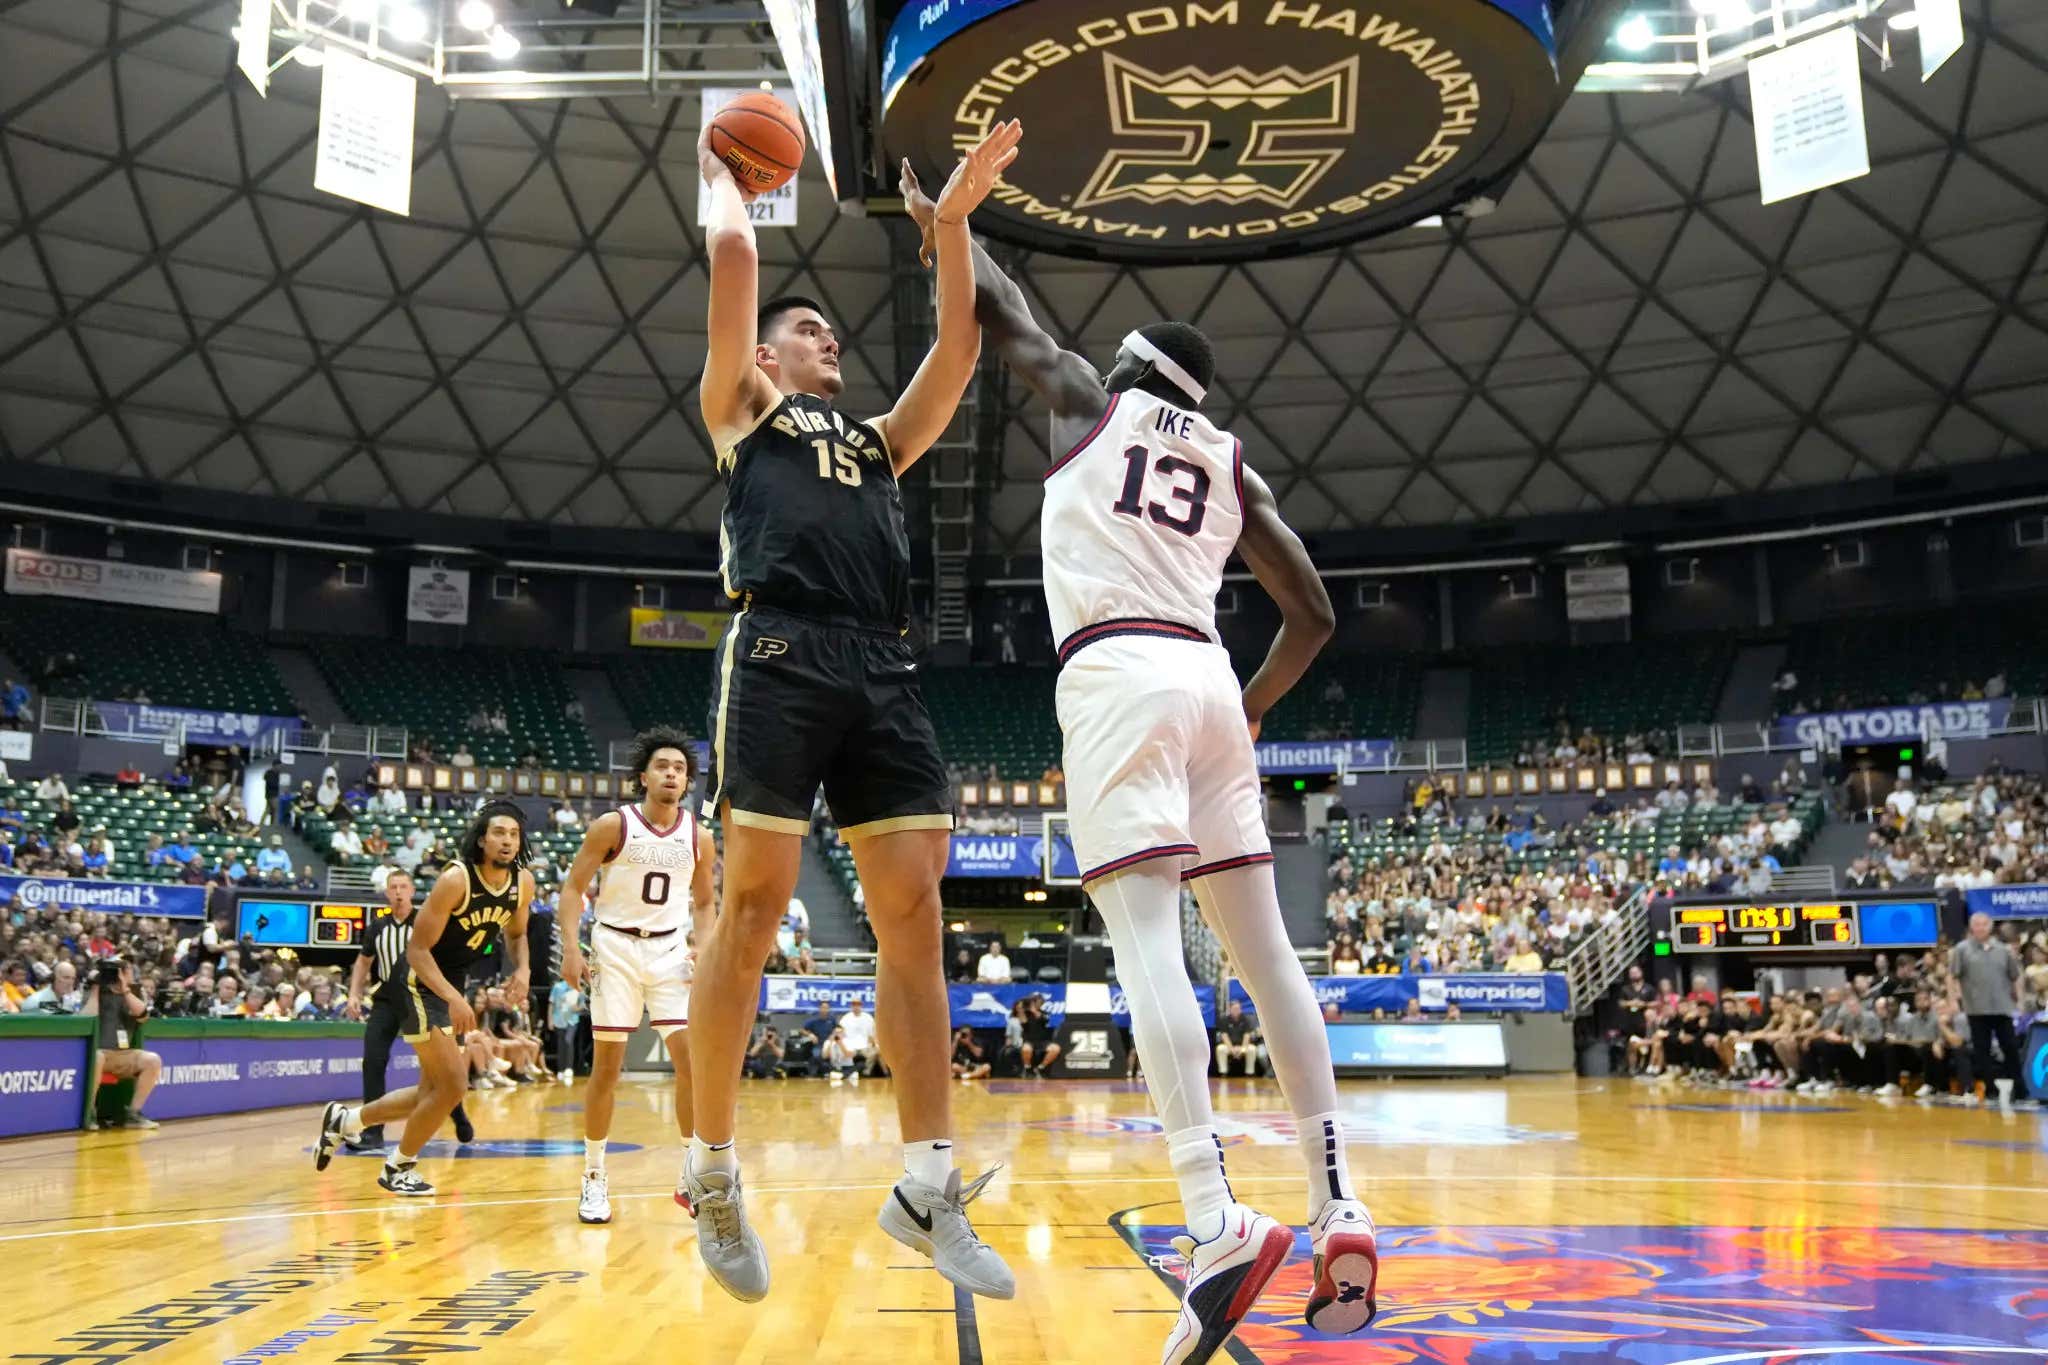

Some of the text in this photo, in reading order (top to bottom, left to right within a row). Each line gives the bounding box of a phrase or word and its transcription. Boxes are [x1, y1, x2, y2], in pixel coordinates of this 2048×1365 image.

[770, 406, 882, 462] PURDUE
[1155, 406, 1194, 440] IKE
[811, 439, 862, 487] 15
[1112, 444, 1211, 537] 13
[16, 558, 98, 582] PODS
[751, 637, 788, 659] P
[138, 704, 216, 730] hmsa
[1796, 702, 1991, 743] GATORADE
[627, 843, 692, 873] ZAGS
[956, 841, 1017, 861] MAUI
[17, 879, 142, 908] Continental
[642, 871, 671, 906] 0
[459, 905, 512, 931] PURDU
[466, 928, 488, 951] 4
[770, 985, 876, 1006] enterpri
[1424, 983, 1542, 1003] enterprise
[1070, 1031, 1108, 1054] 25
[0, 1068, 77, 1094] ORTSLIVE
[173, 1063, 241, 1084] INVITATIONAL
